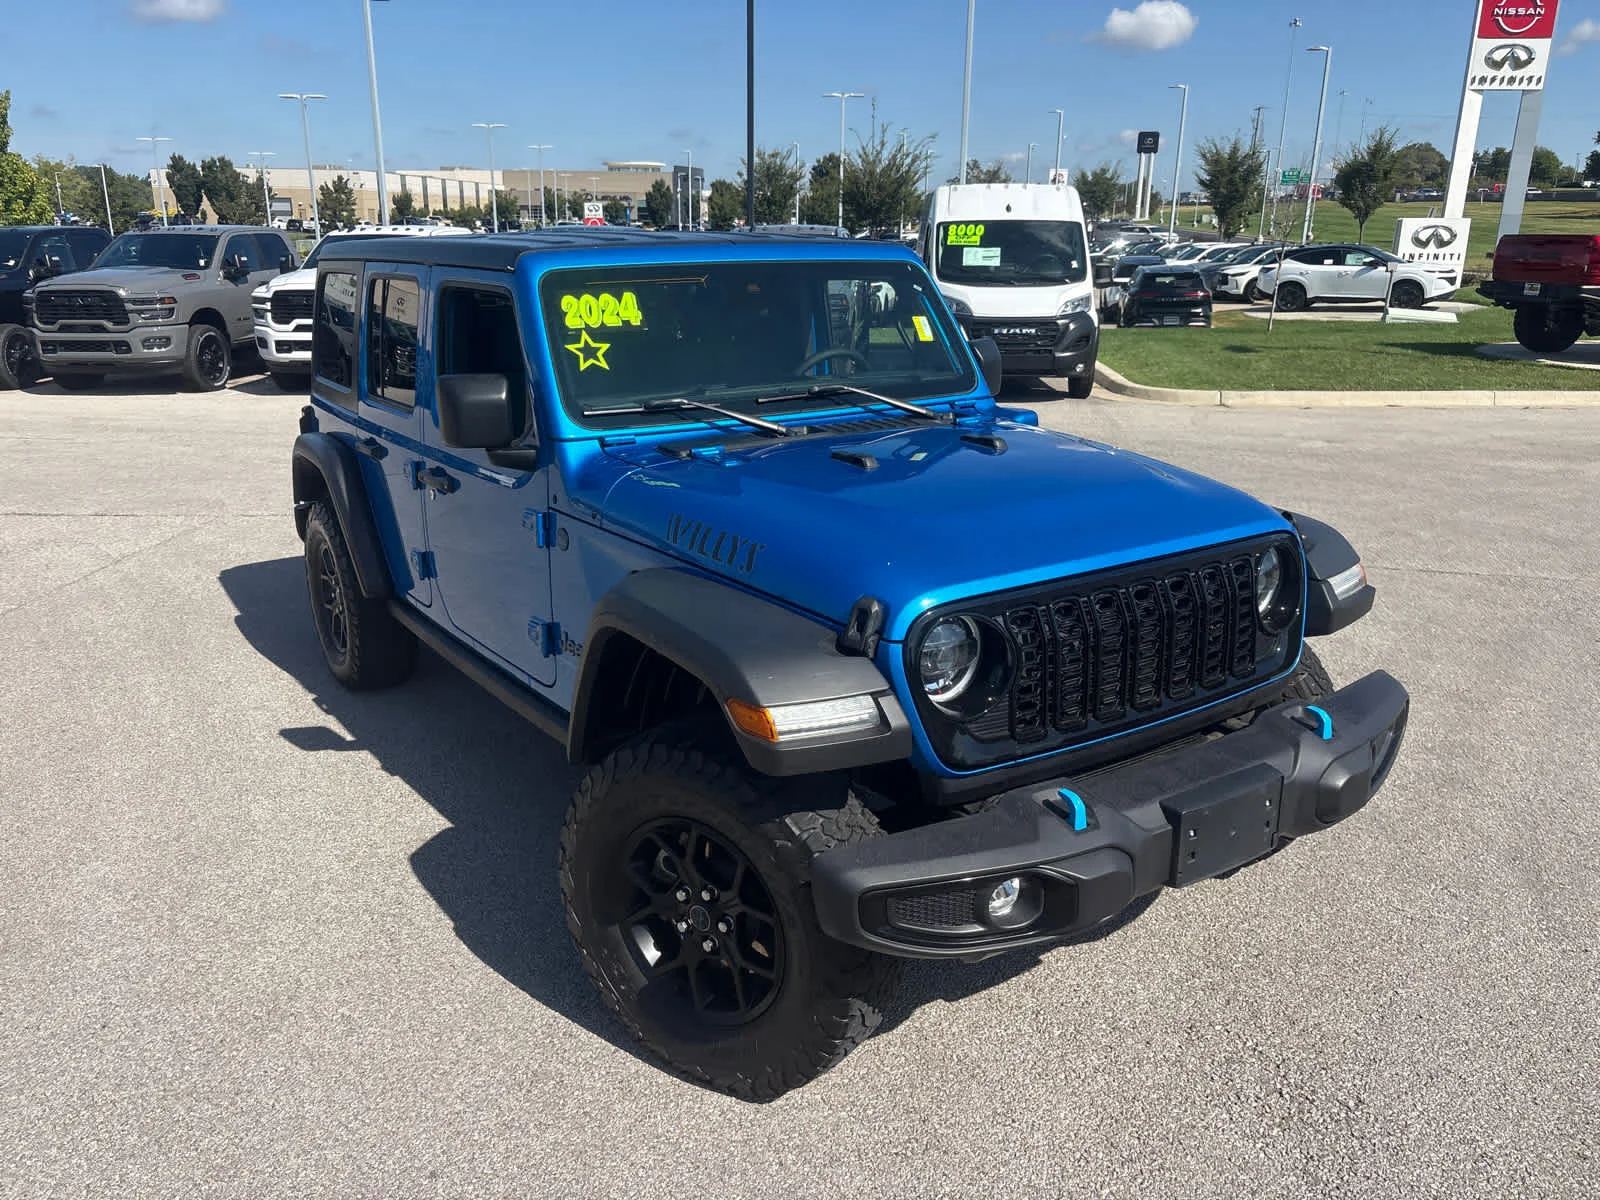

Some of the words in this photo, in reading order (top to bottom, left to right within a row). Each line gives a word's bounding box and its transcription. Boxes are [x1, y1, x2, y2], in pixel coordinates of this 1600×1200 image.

[1494, 7, 1545, 15] NISSAN
[1470, 75, 1543, 87] INFINITI
[948, 224, 985, 236] 8000
[1402, 252, 1461, 261] INFINITI
[561, 292, 642, 328] 2024
[666, 512, 766, 573] WILLYS
